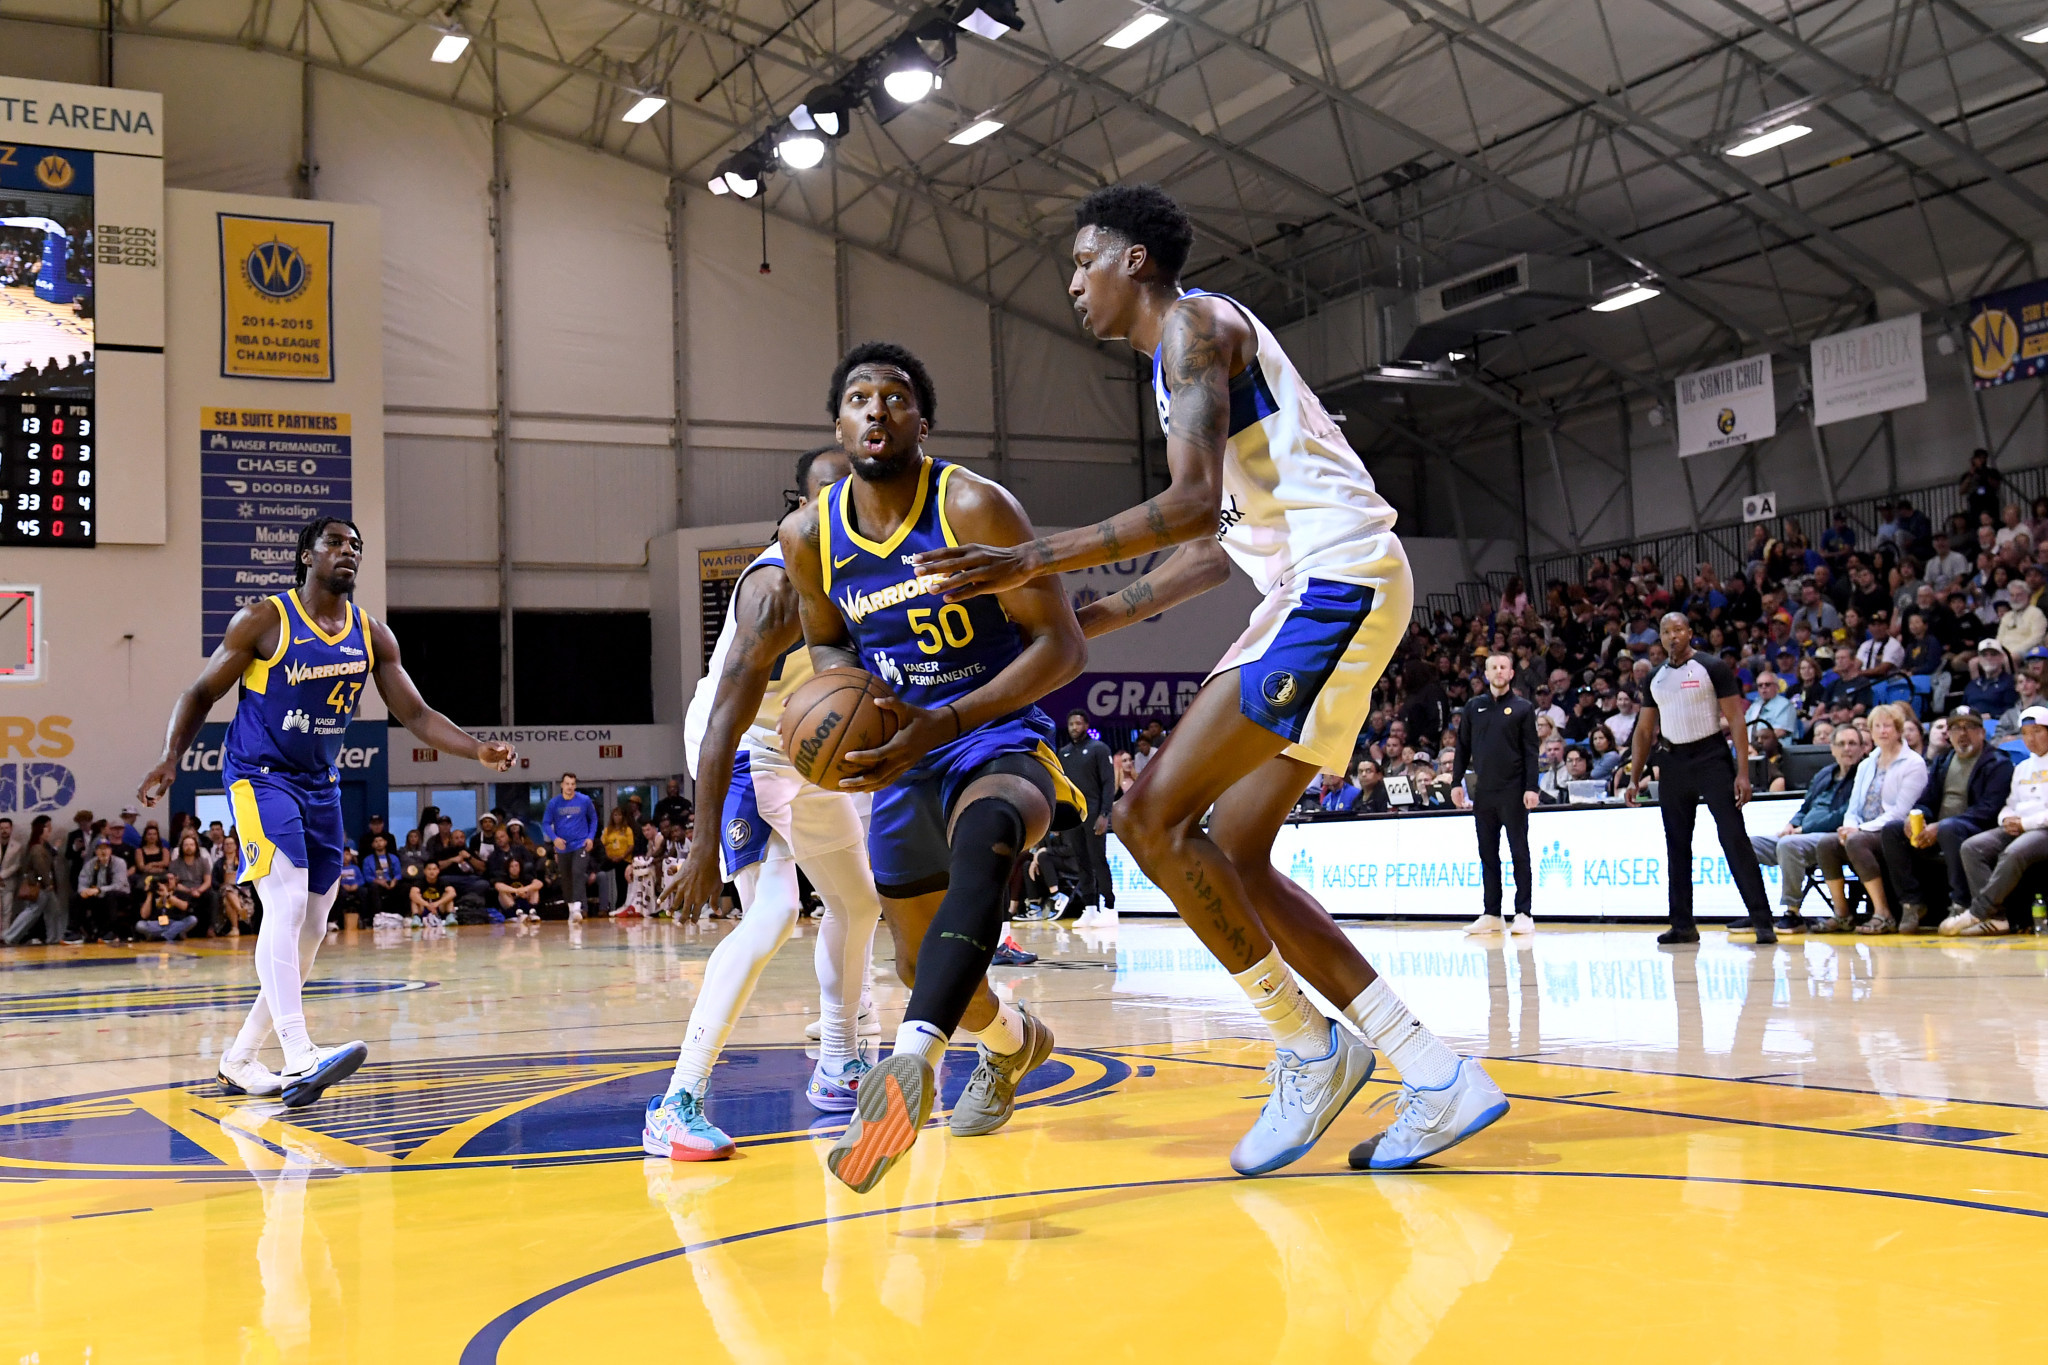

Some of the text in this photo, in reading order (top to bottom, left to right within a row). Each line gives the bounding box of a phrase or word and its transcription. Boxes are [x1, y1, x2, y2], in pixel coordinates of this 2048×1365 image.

[48, 103, 154, 135] ARENA
[242, 315, 314, 331] 2014-2015
[235, 334, 321, 349] NBA D-LEAGUE
[236, 348, 321, 364] CHAMPIONS
[1821, 322, 1914, 381] PARADOX
[1681, 359, 1765, 405] UC SANTA CRUZ
[21, 403, 88, 416] NO F PTS
[22, 417, 91, 436] 13 0 3
[215, 411, 338, 431] SEA SUITE PARTNERS
[27, 442, 91, 462] 2 0 3
[231, 439, 267, 451] KAISER
[236, 458, 298, 473] CHASE
[28, 468, 91, 487] 3 0 0
[251, 482, 331, 495] DOORDASH
[17, 493, 91, 512] 33 0 4
[258, 503, 318, 519] invisalign
[1760, 498, 1773, 515] A
[16, 519, 91, 537] 45 0 7
[255, 526, 300, 543] Modelo
[250, 547, 297, 564] Rakute
[702, 551, 761, 568] WARRIO
[235, 570, 297, 586] RingCen
[906, 603, 975, 655] 50
[284, 658, 367, 687] WARRIORS
[903, 661, 940, 674] KAISER
[908, 662, 982, 686] PERMANENTE
[315, 717, 337, 726] KAISER
[313, 726, 346, 735] PERMANENT
[794, 710, 843, 777] Wilson
[1322, 864, 1378, 888] KAISER
[1584, 858, 1659, 886] KAISER
